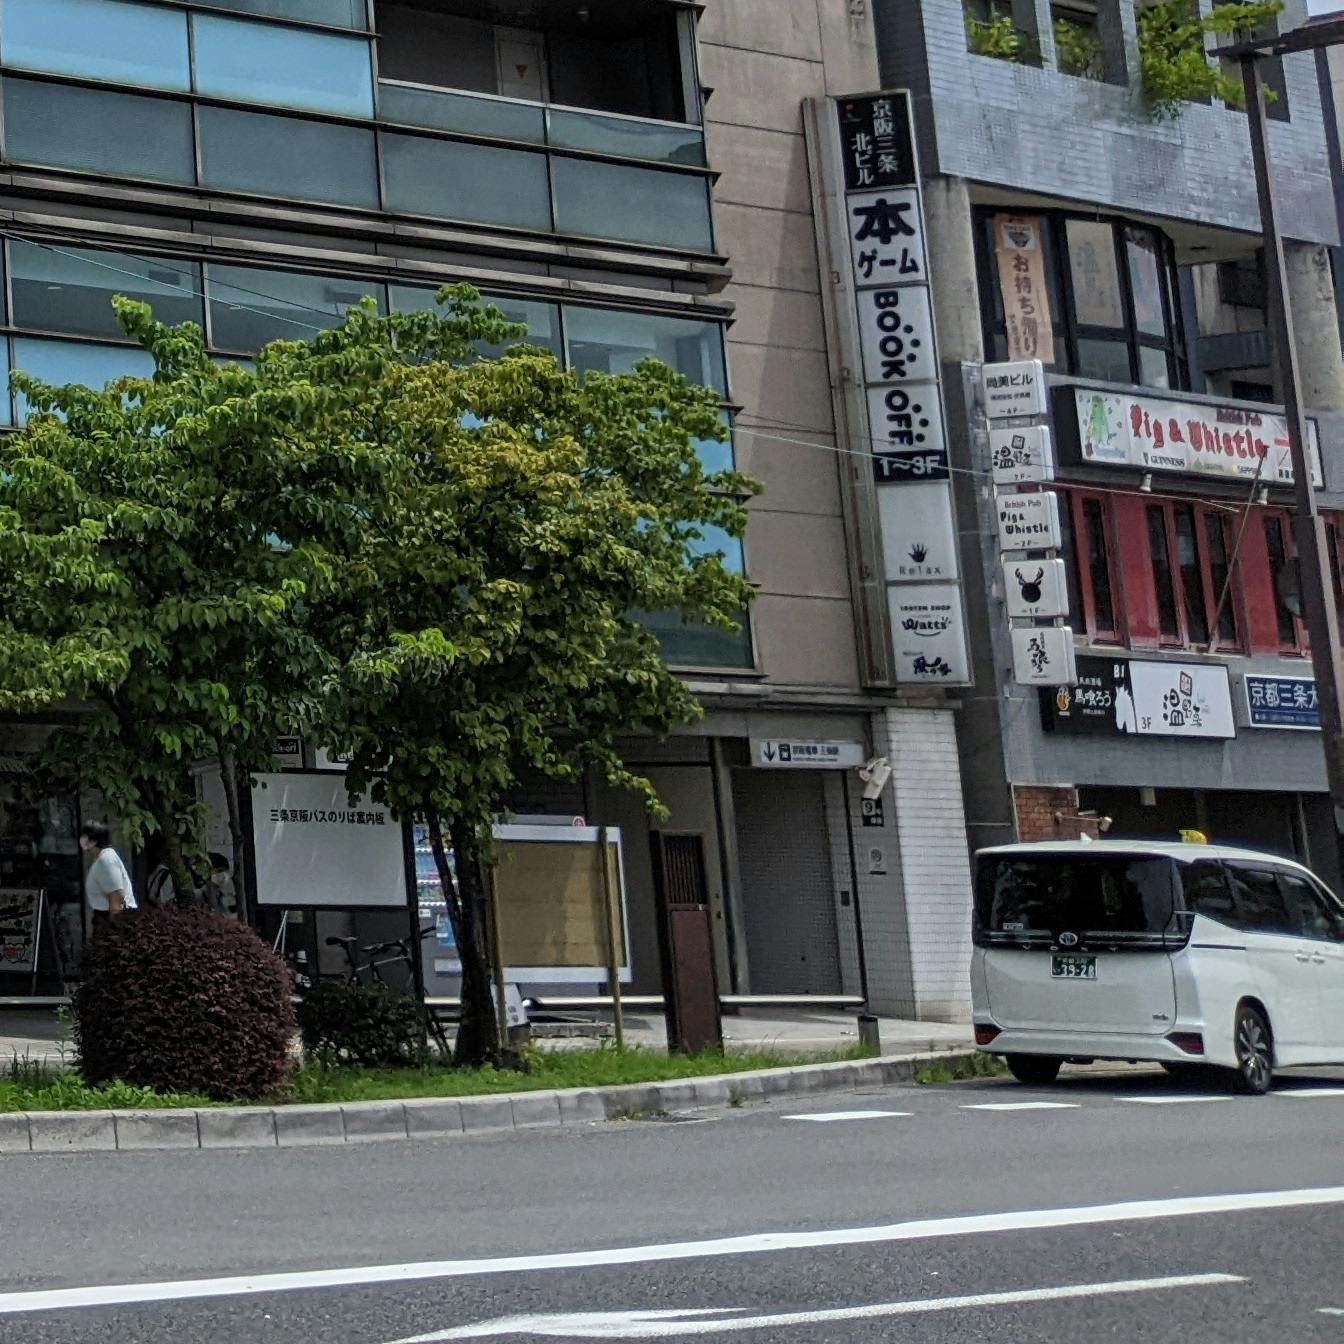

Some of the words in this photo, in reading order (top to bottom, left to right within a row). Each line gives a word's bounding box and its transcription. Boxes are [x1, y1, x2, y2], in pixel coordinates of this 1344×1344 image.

[850, 132, 875, 186] 北ビル
[872, 99, 899, 174] 京阪三条
[853, 197, 916, 245] 本
[857, 247, 920, 279] ゲーム
[1129, 403, 1165, 449] Pig
[1187, 419, 1268, 459] Whistle
[1005, 522, 1050, 536] Whistle
[1141, 716, 1153, 731] 3F
